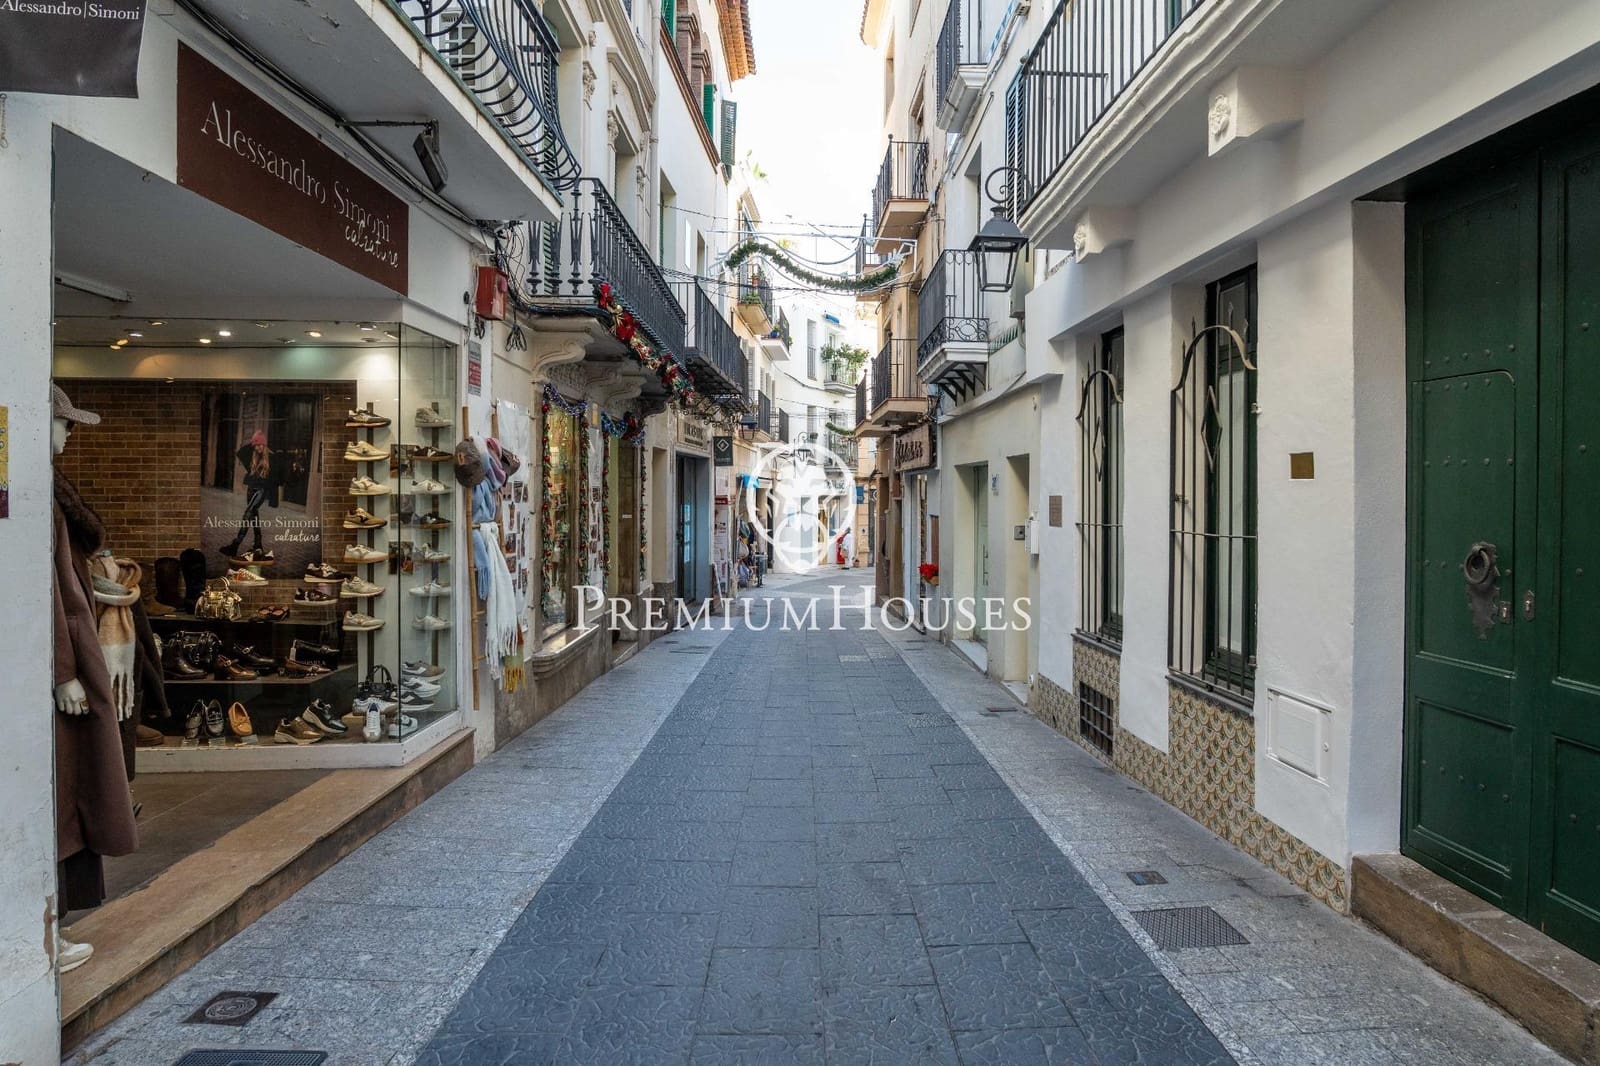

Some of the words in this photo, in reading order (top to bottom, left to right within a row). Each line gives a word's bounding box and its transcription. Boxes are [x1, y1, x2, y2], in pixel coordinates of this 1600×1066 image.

[200, 100, 326, 204] Alessandro
[333, 181, 390, 243] Simoni
[203, 515, 272, 528] Alessandro
[275, 516, 319, 528] Simoni
[274, 529, 320, 542] calzature
